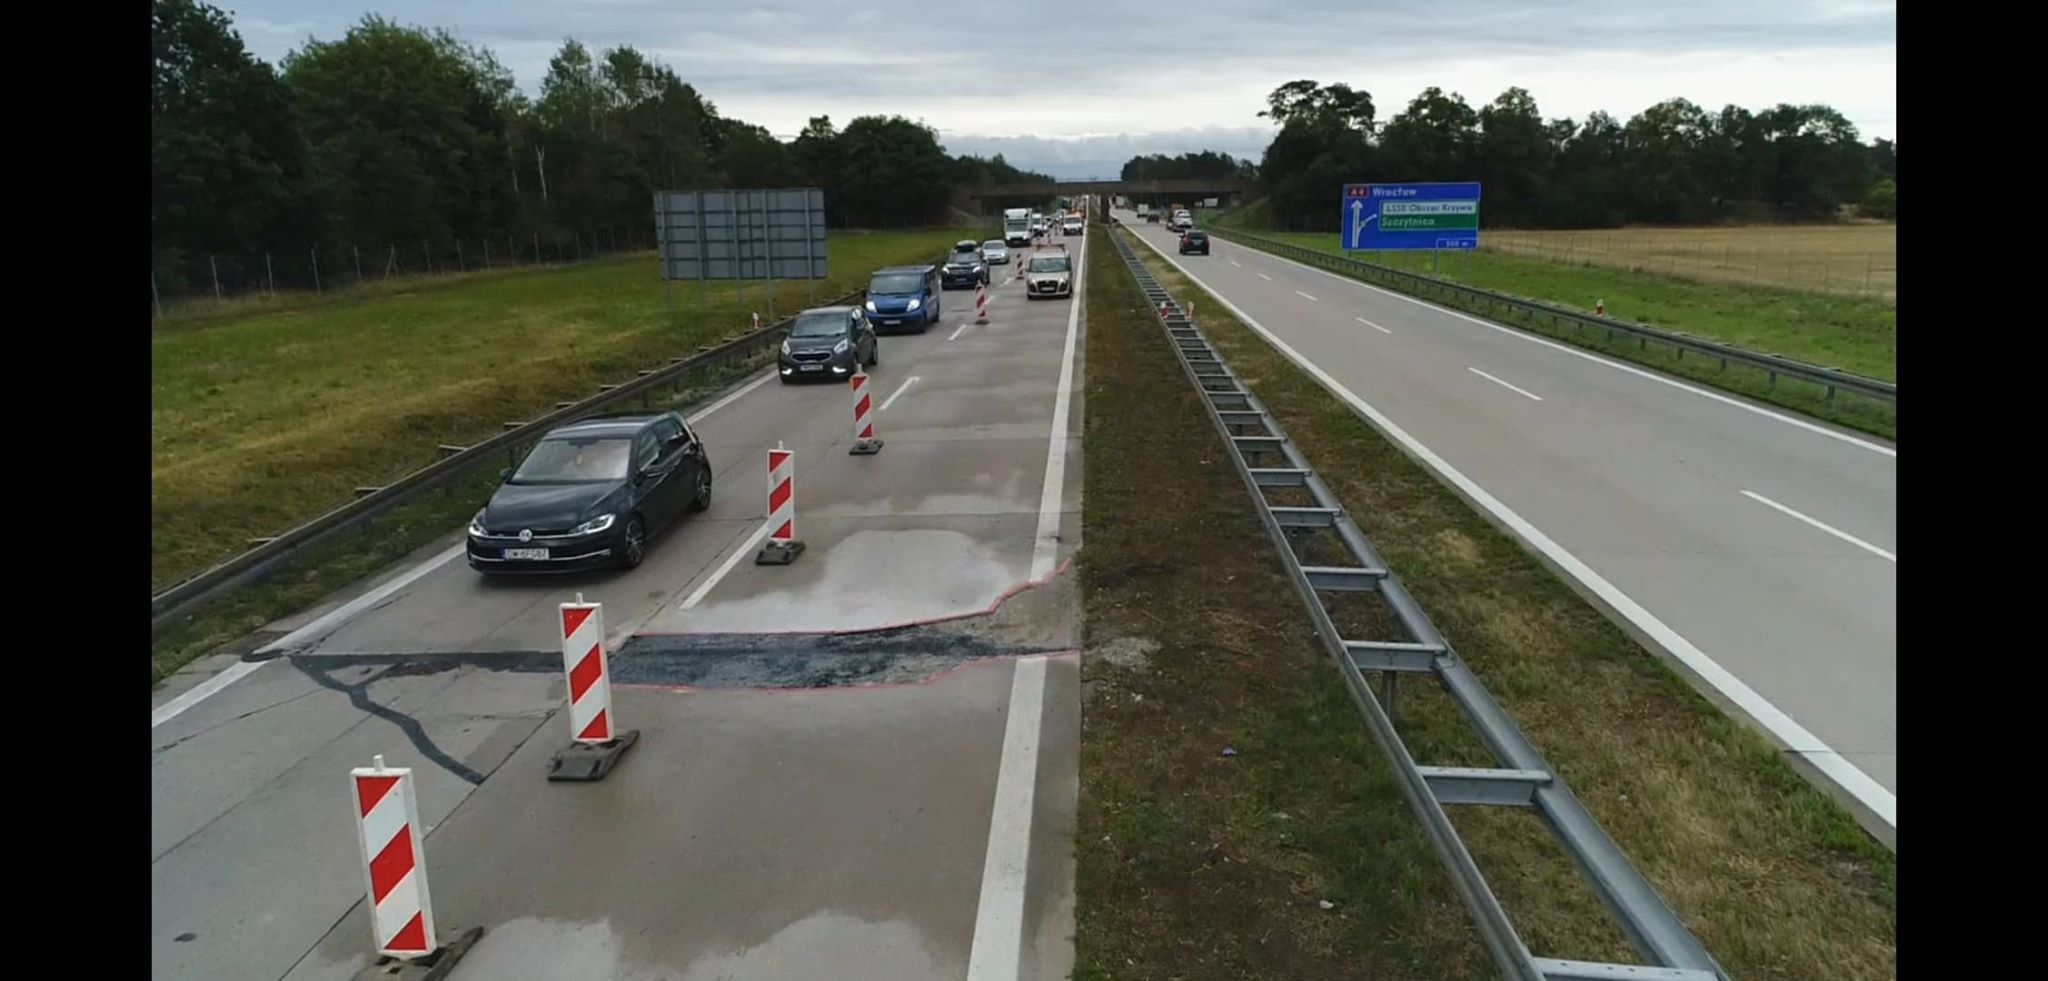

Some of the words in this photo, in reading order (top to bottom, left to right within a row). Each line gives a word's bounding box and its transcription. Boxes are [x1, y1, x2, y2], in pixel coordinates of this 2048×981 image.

[1350, 187, 1365, 196] A4
[1372, 187, 1417, 197] Wrocław
[1442, 203, 1473, 213] Krzywa
